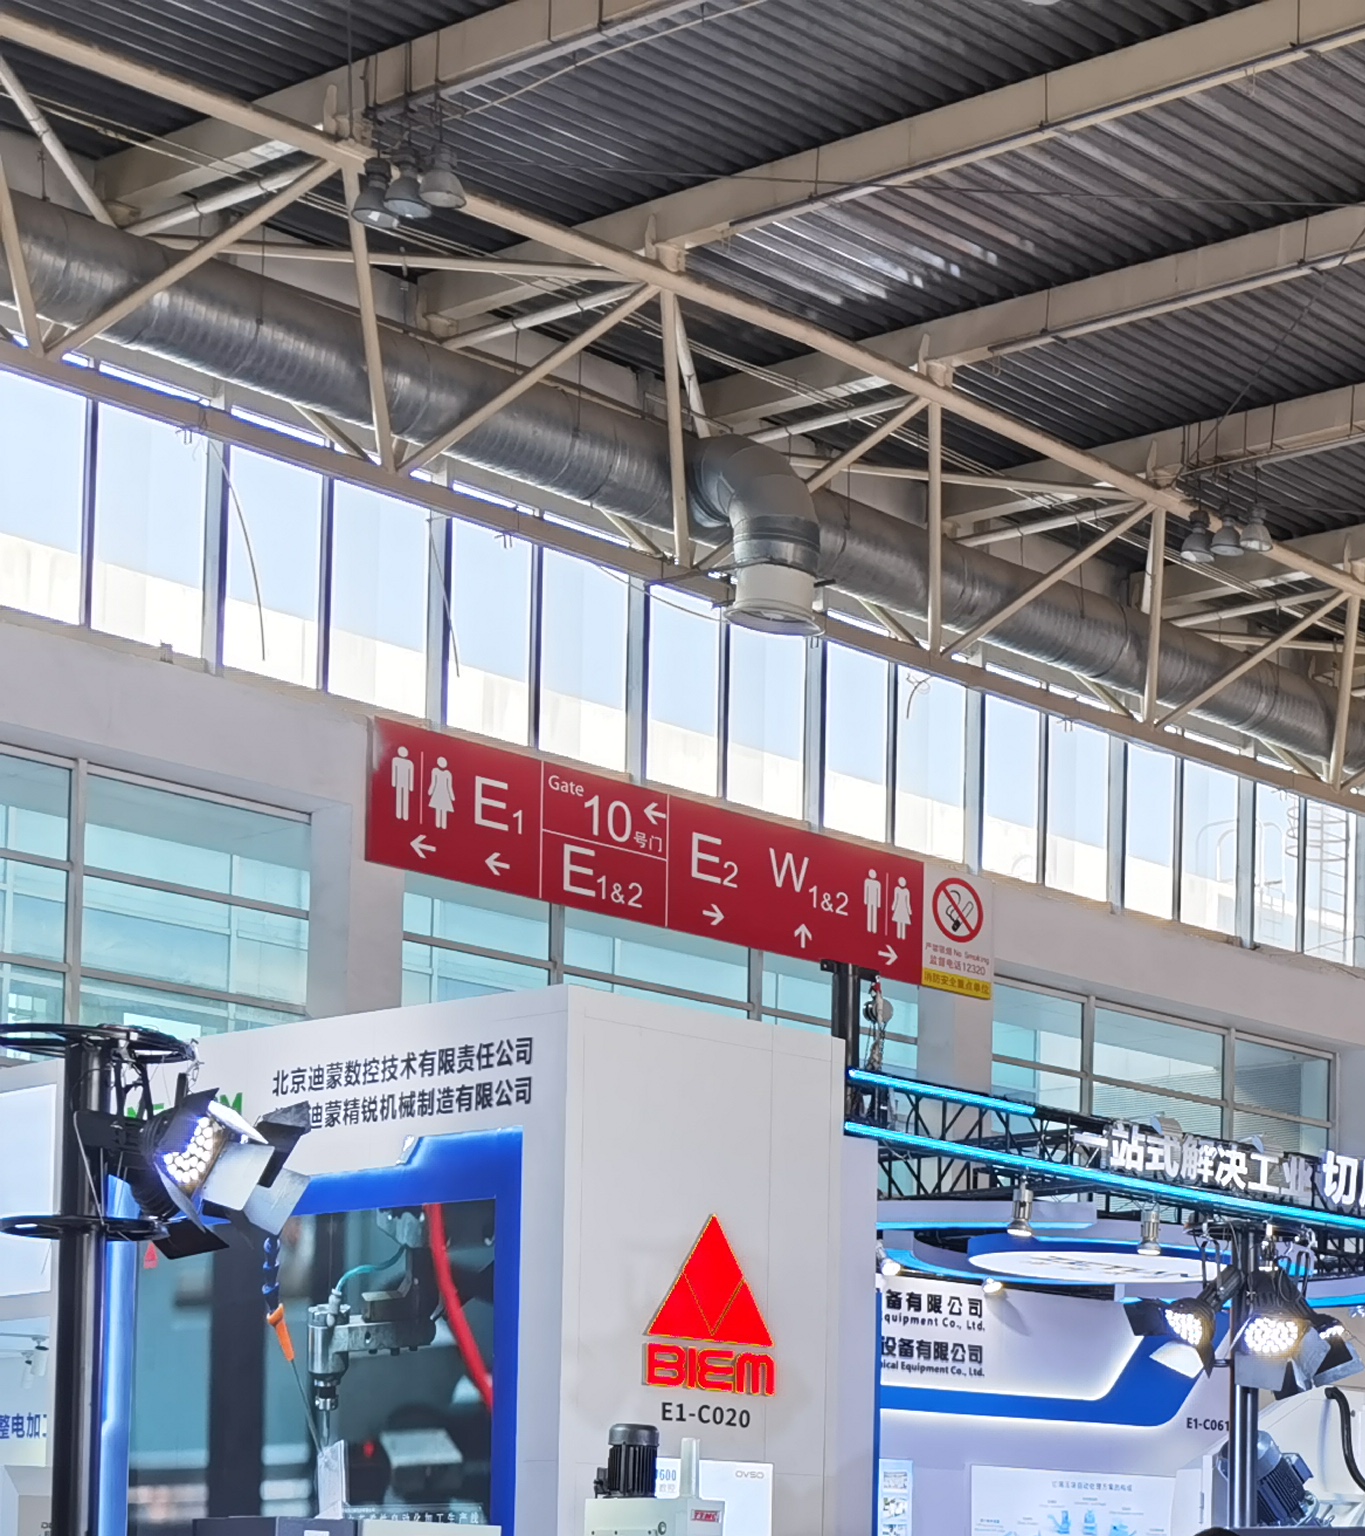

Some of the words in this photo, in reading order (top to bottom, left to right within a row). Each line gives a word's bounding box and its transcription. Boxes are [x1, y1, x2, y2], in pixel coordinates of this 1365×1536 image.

[474, 775, 523, 835] E1
[548, 775, 585, 797] Gate
[563, 843, 643, 909] E1&2
[690, 831, 739, 889] E2
[769, 847, 849, 917] W1&2
[272, 1036, 533, 1097] 北京迪蒙数控技术有限责任公司
[276, 1076, 533, 1130] 迪蒙精锐机械制造有限公司
[882, 1313, 938, 1326] quipment
[645, 1342, 776, 1397] BIEM
[881, 1361, 898, 1370] ical
[901, 1362, 948, 1374] Equipment
[661, 1403, 751, 1428] E1-C020
[657, 1469, 677, 1482] 600
